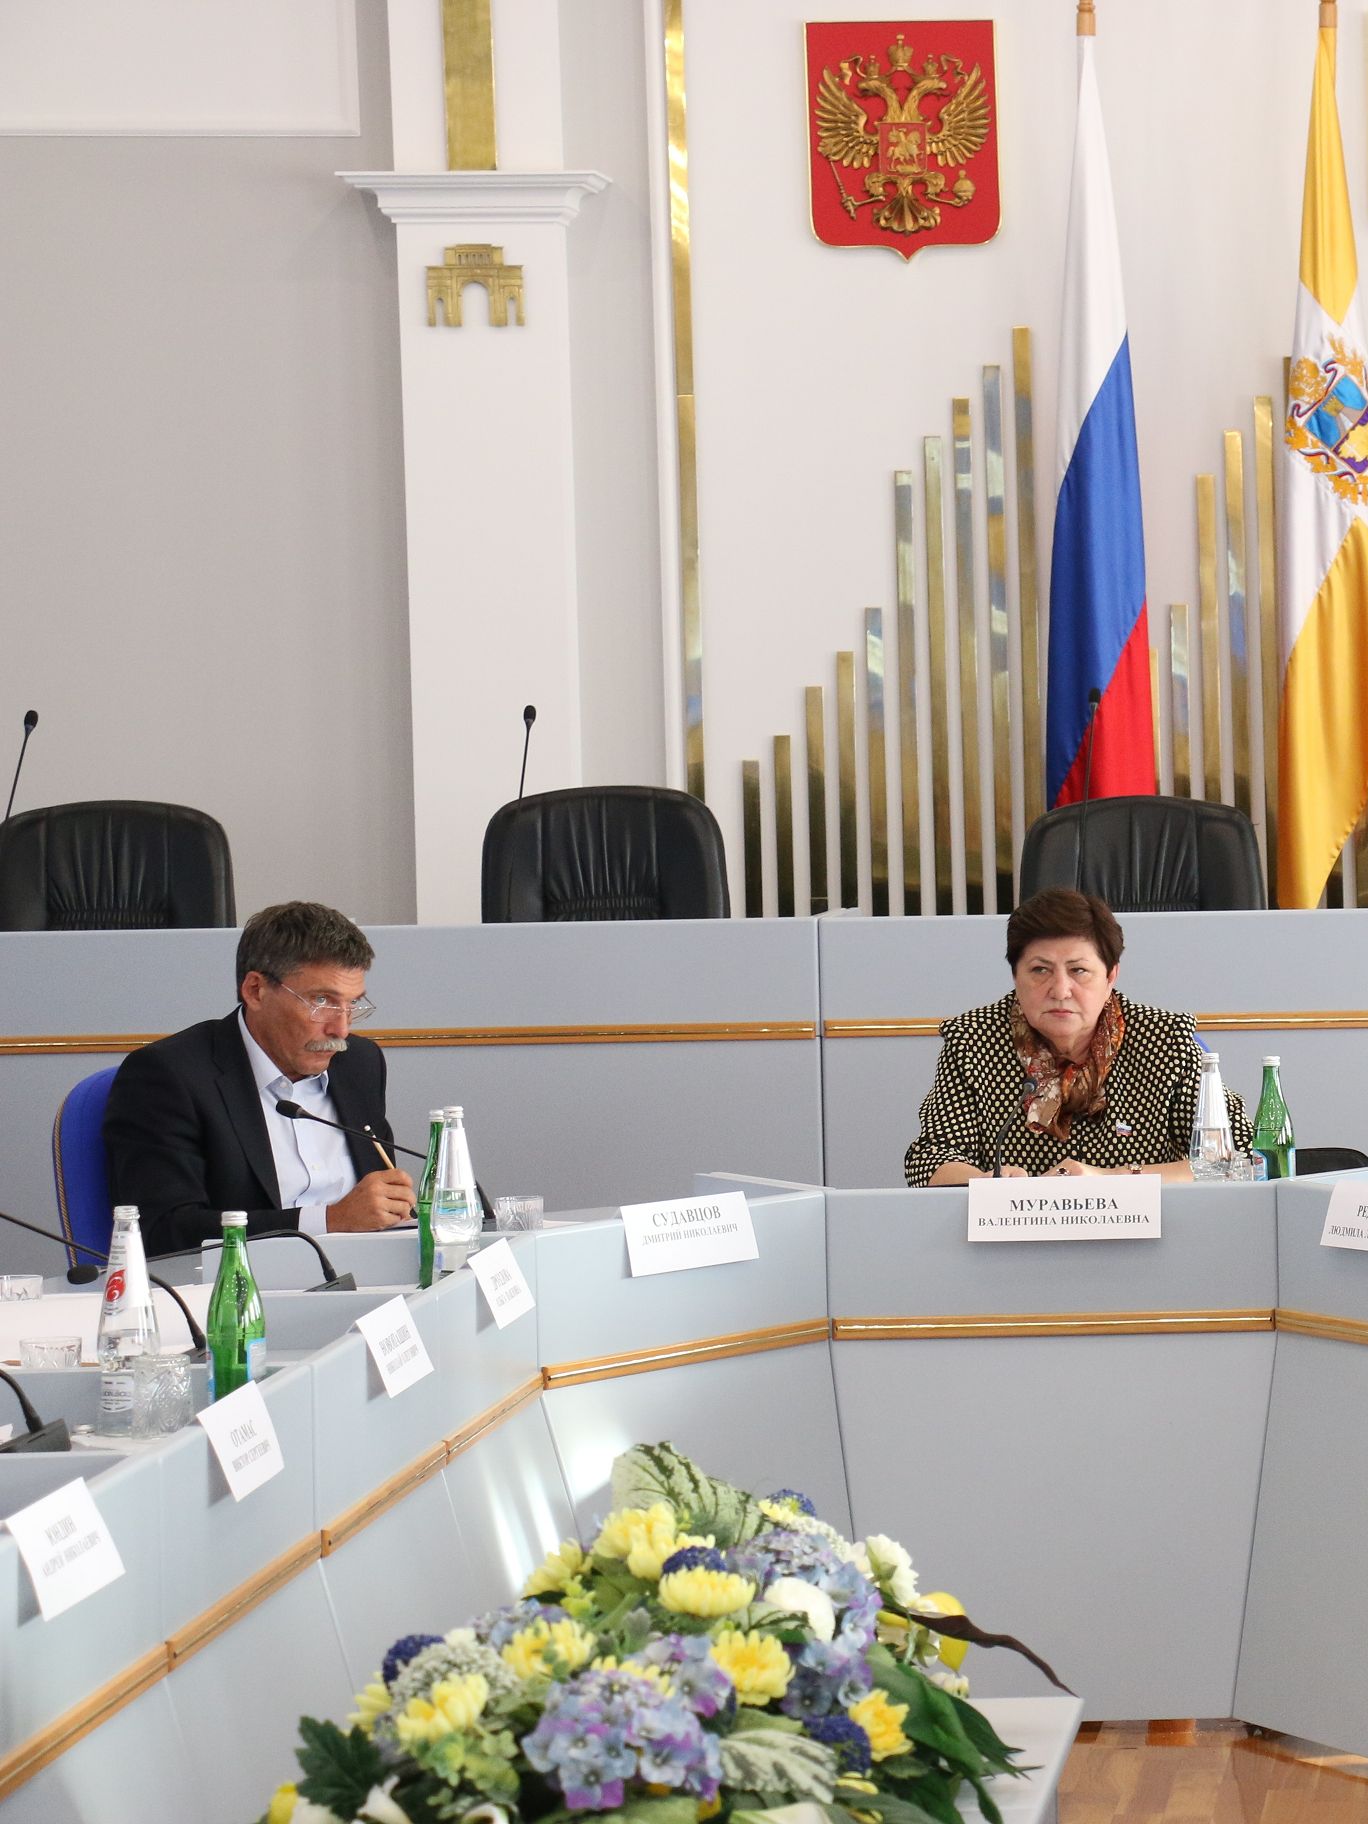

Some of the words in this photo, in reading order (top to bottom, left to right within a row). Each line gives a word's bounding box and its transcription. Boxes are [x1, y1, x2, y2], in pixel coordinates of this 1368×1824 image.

[1009, 1197, 1119, 1212] МУРАВЬЕВА
[652, 1205, 721, 1227] СУДАВЦОВ
[978, 1216, 1057, 1227] ВАЛЕНТИНА
[1061, 1214, 1150, 1225] НИКОЛАЕВНА
[642, 1229, 682, 1246] ДМИТРИЙ
[683, 1223, 738, 1240] НИКОЛАЕВИЧ
[1328, 1225, 1364, 1239] ЛЮДМИЛА
[230, 1420, 257, 1448] ОТАМАС
